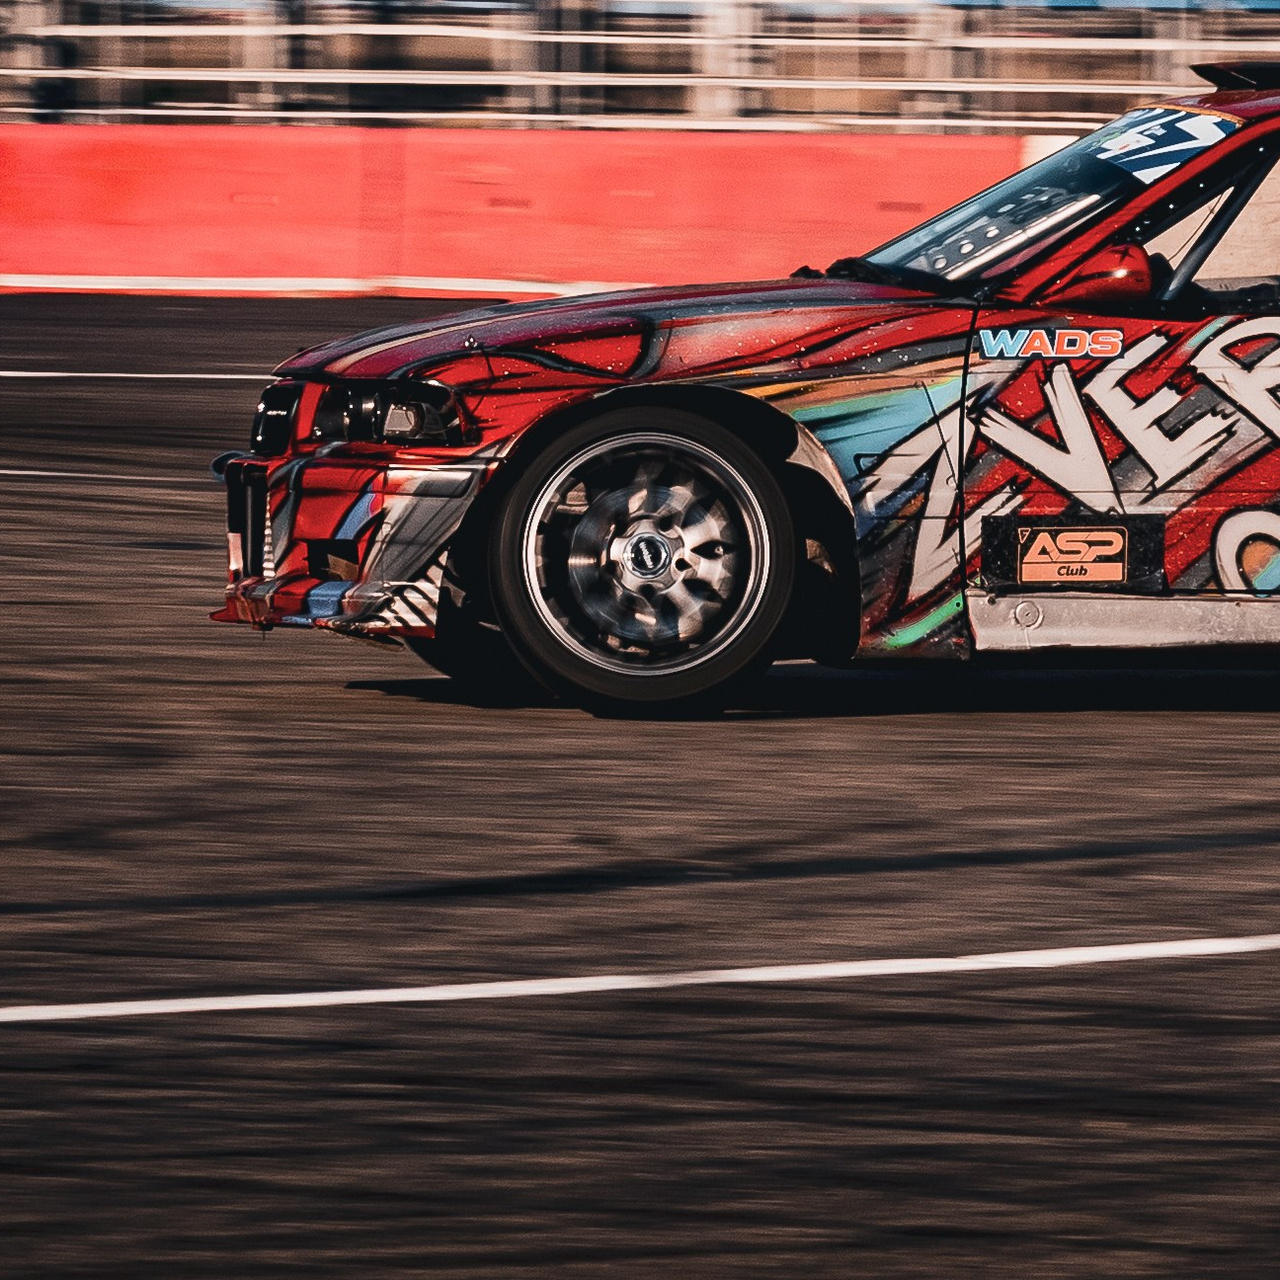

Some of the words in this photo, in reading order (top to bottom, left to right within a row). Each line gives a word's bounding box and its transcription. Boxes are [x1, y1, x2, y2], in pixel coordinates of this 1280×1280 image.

[979, 329, 1124, 358] WADS
[1022, 531, 1124, 562] ASP
[1056, 565, 1089, 577] Club
